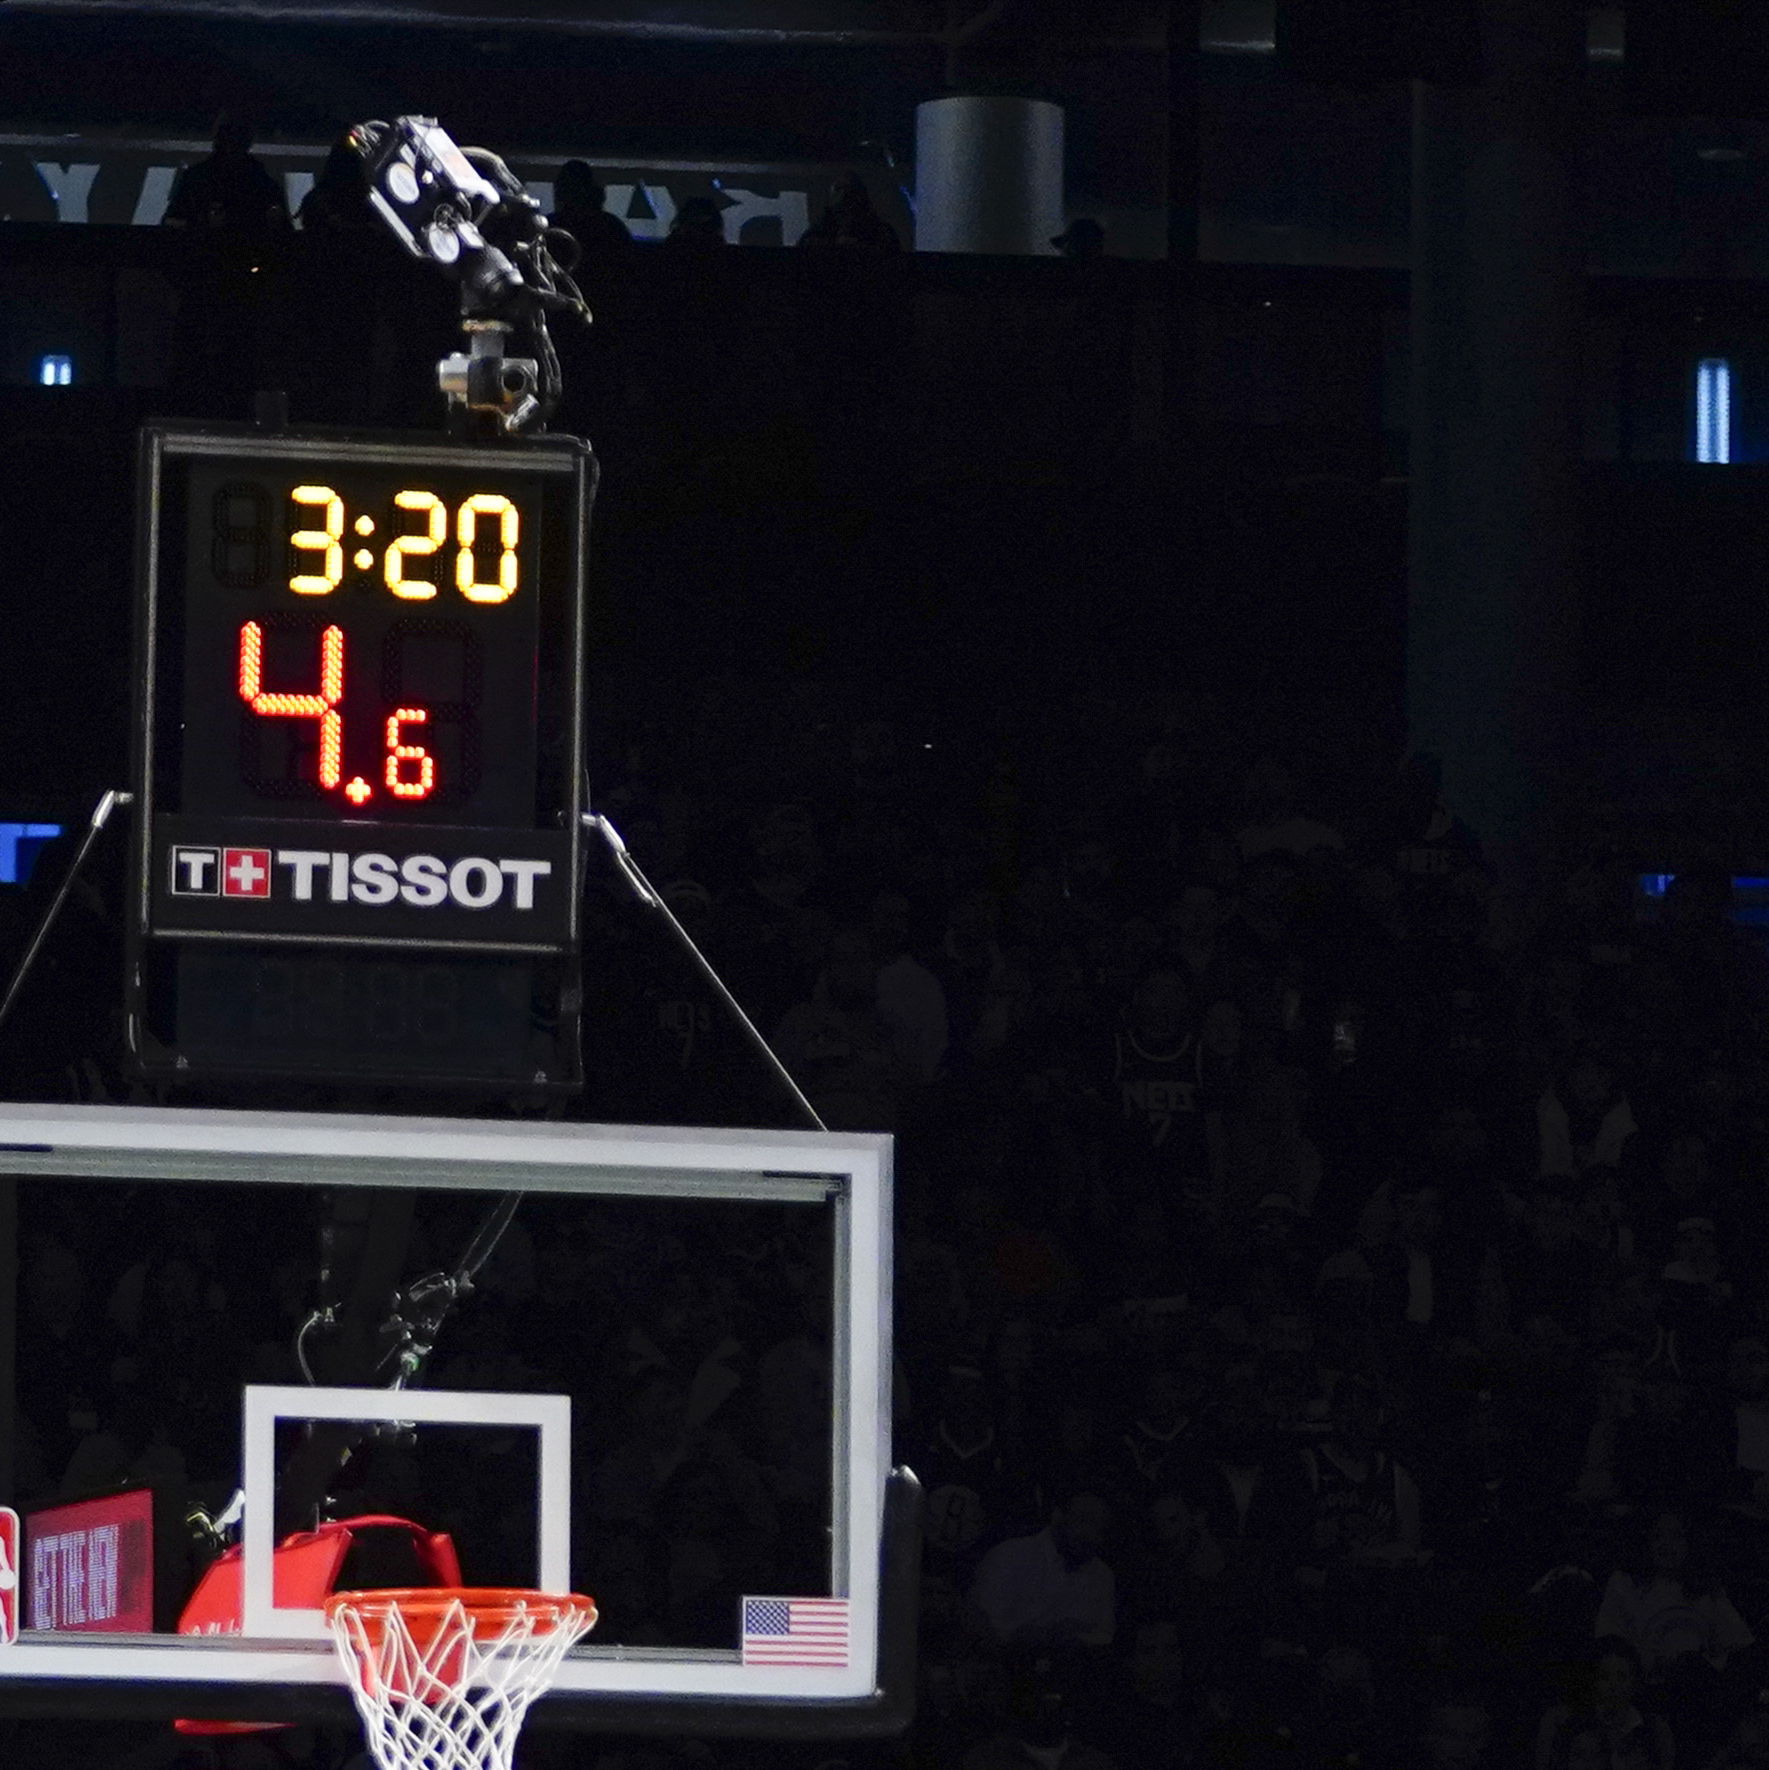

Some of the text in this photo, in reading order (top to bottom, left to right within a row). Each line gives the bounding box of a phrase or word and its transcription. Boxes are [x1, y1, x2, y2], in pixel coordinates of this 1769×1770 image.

[290, 485, 519, 602] 3:20
[278, 850, 551, 909] TISSOT
[1122, 1080, 1195, 1117] NETS
[1148, 1112, 1172, 1147] 7
